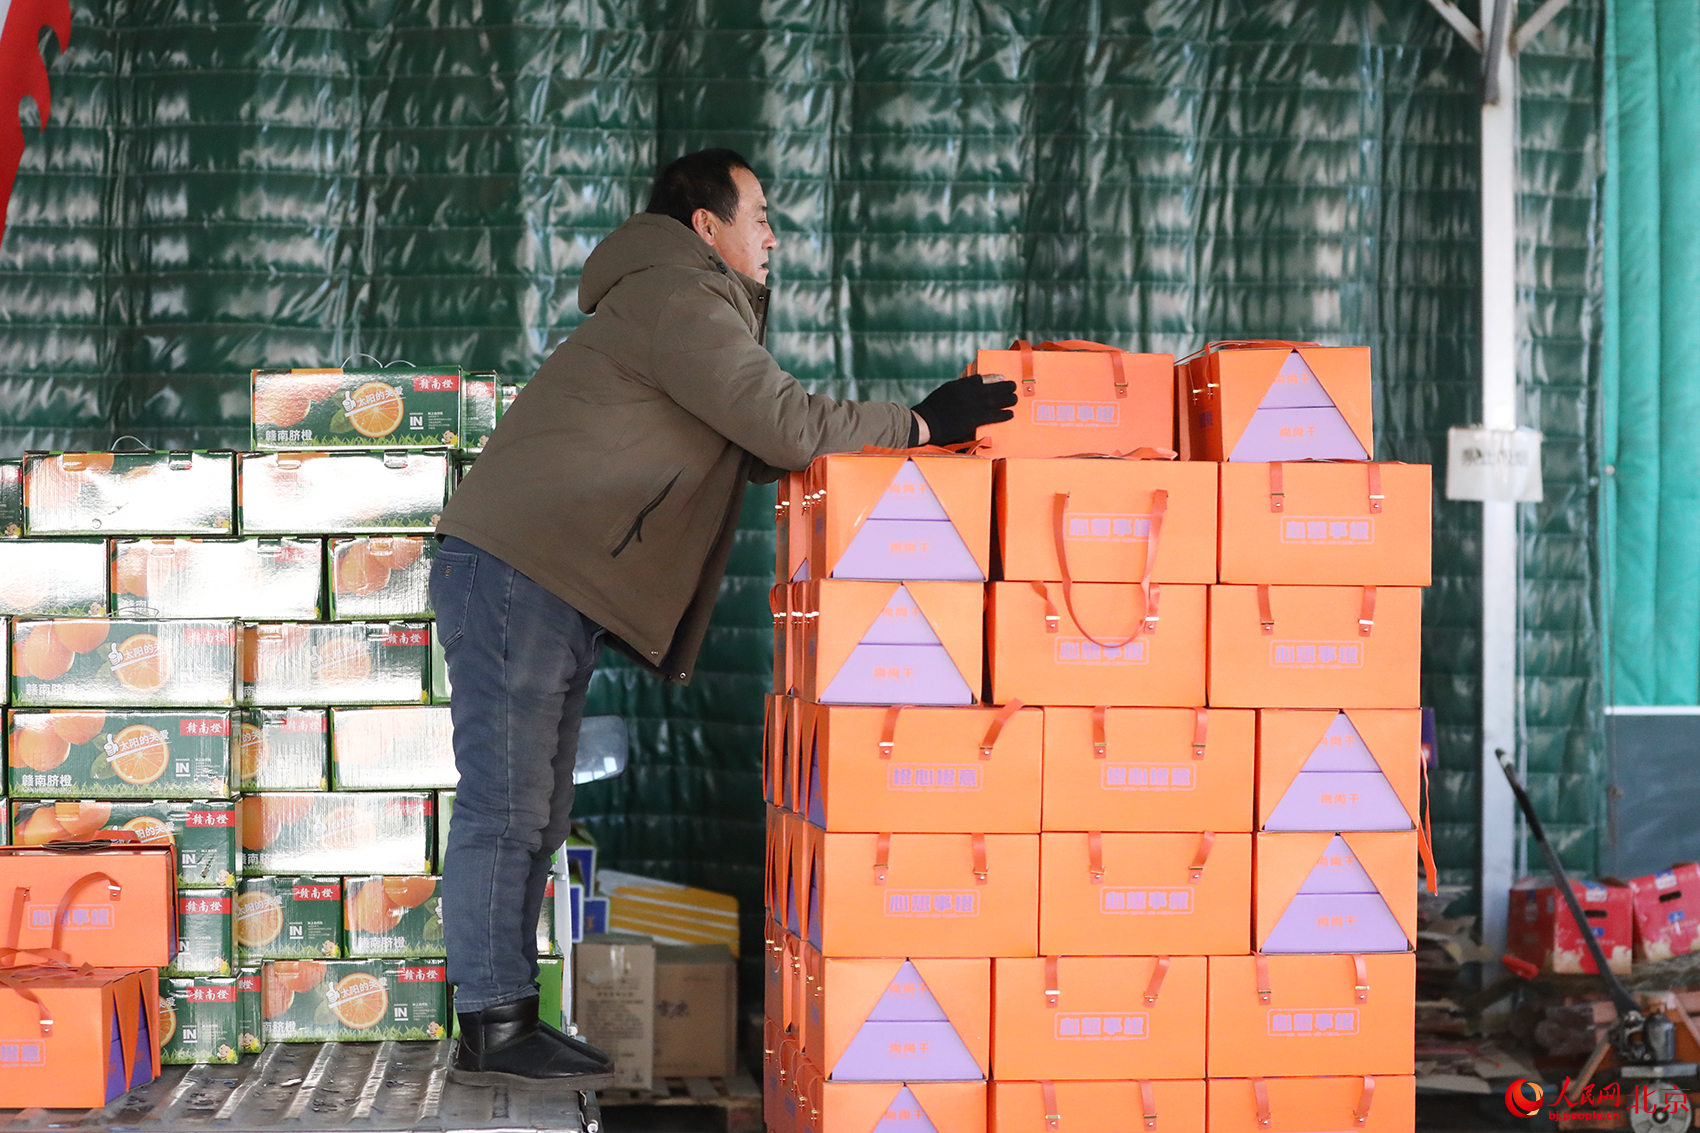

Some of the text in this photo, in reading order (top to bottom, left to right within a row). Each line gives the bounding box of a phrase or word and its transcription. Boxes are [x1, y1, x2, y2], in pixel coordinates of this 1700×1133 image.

[420, 377, 454, 390] 赣南橙
[1036, 404, 1115, 422] 心想事橙
[409, 416, 423, 427] IN
[1285, 521, 1369, 539] 心想事橙
[1060, 641, 1144, 661] 心想事橙
[1275, 645, 1358, 663] 心想事橙
[185, 721, 223, 734] 赣南橙
[175, 762, 190, 773] IN
[21, 774, 72, 787] 赣南脐橙
[892, 768, 977, 786] 橙心橙意
[1106, 767, 1191, 786] 橙心橙意
[191, 812, 229, 825] 赣南橙
[181, 853, 196, 865] IN
[299, 887, 334, 899] 赣南橙
[185, 900, 223, 913] 赣南橙
[889, 894, 974, 912] 心想事橙
[1105, 891, 1189, 910] 心想事橙
[289, 925, 303, 936] IN
[403, 969, 439, 981] 赣南橙
[193, 988, 229, 1001] 赣南橙
[394, 1007, 408, 1018] IN
[1059, 1017, 1144, 1036] 心想事橙
[1272, 1013, 1355, 1031] 心想事橙
[182, 1028, 197, 1040] IN
